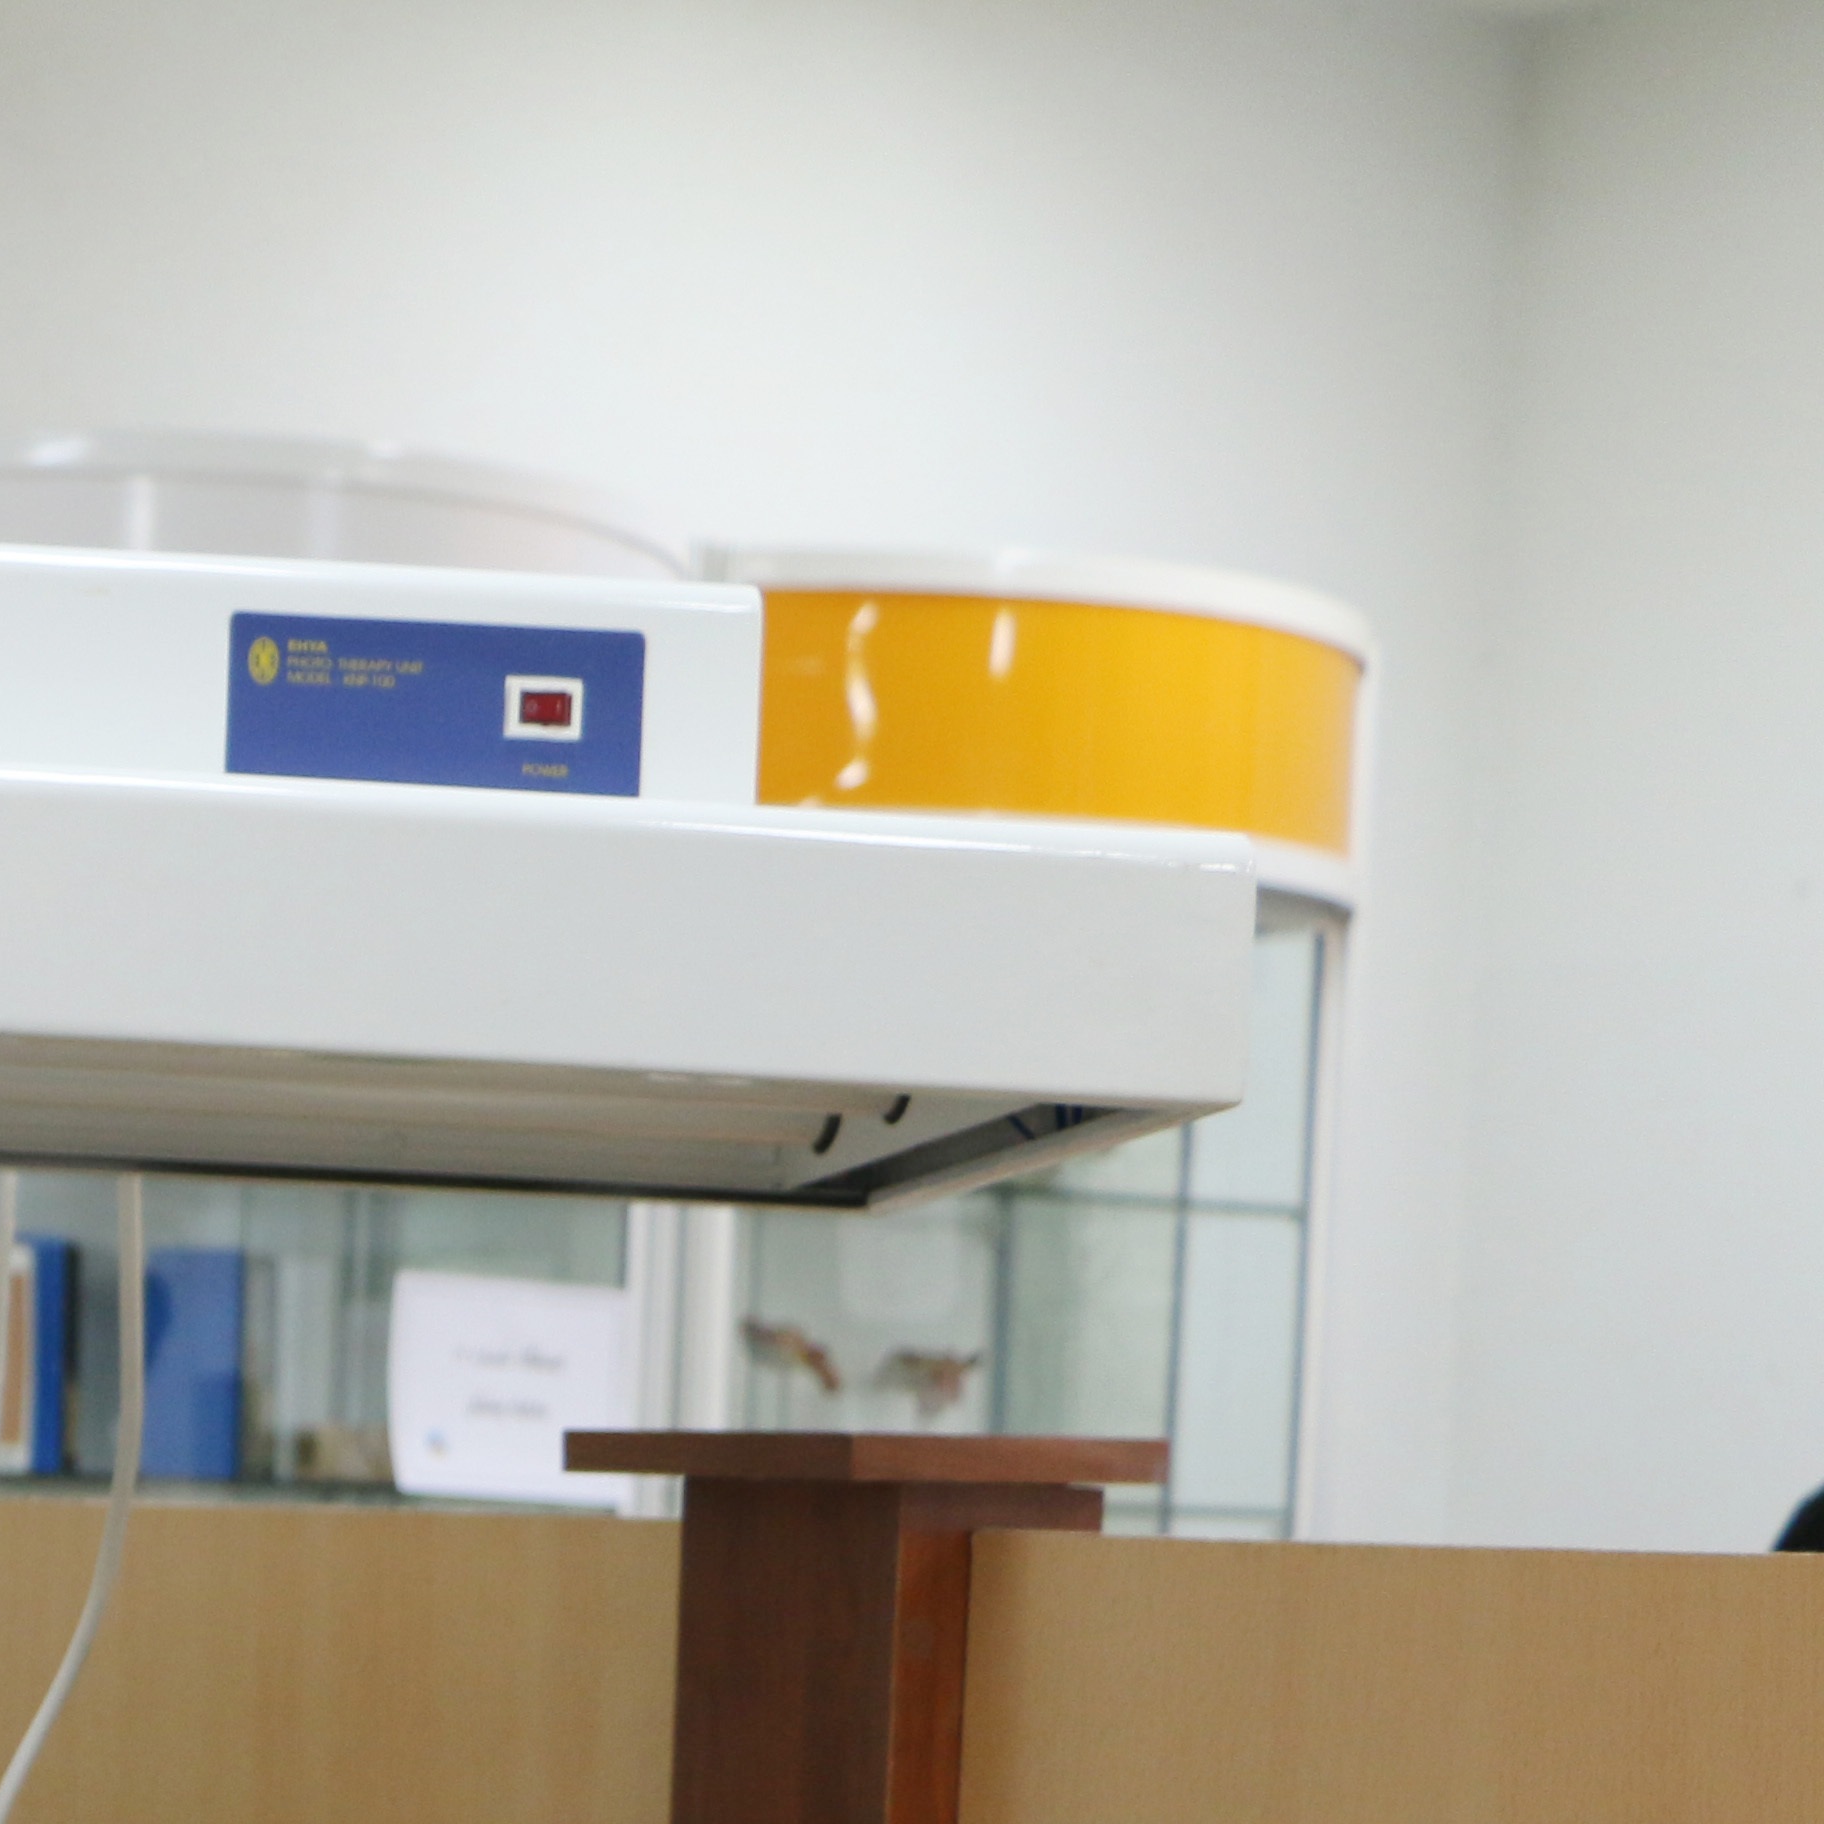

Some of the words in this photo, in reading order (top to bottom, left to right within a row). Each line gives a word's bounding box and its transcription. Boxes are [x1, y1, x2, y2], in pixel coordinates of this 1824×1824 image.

[287, 655, 332, 668] PHOTO
[338, 658, 393, 672] THERAPY
[395, 661, 424, 674] UNIT
[521, 762, 569, 778] POWER
